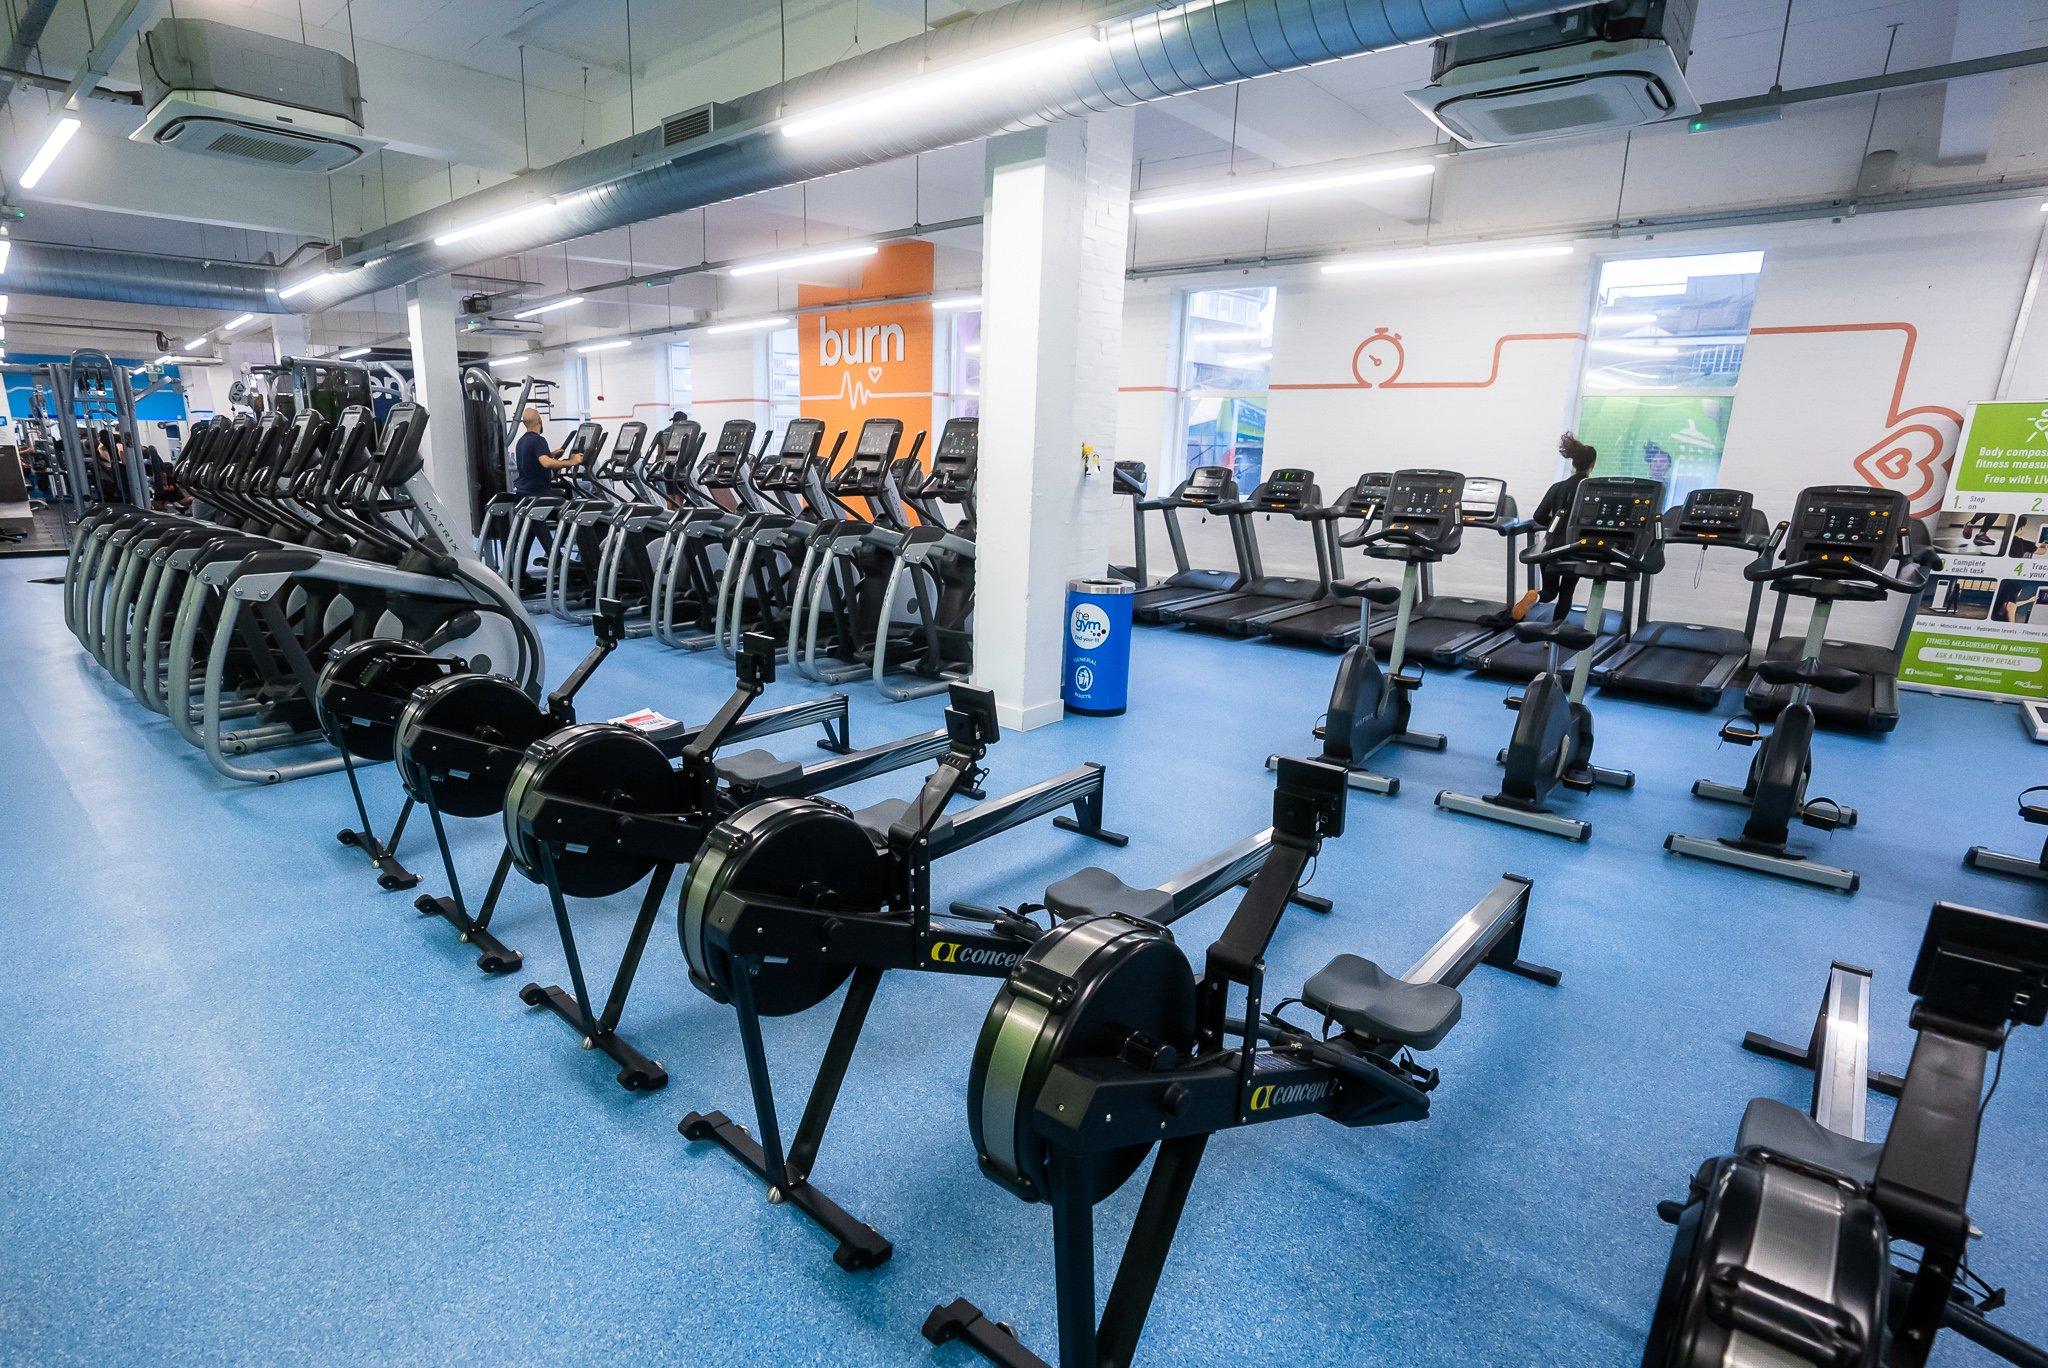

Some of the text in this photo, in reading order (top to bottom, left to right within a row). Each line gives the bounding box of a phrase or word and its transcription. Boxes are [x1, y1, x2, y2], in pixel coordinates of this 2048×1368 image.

[819, 316, 905, 366] burn
[1979, 447, 2048, 458] Body compos
[1976, 459, 2048, 469] fitness measu
[1984, 474, 2005, 484] Free
[2009, 475, 2031, 484] with
[424, 501, 460, 551] MATRIX
[1953, 559, 1986, 567] Complete
[1076, 610, 1089, 620] the
[1076, 620, 1101, 632] gym
[1926, 637, 1951, 645] FITNESS
[1951, 640, 2000, 650] MEASUREMENT
[2009, 646, 2039, 654] MINUTES
[1074, 657, 1097, 666] GENERAL
[1935, 650, 1948, 658] ASK
[1955, 653, 1980, 661] TRAINER
[1996, 658, 2021, 666] DETAILS
[1273, 1080, 1329, 1105] concept
